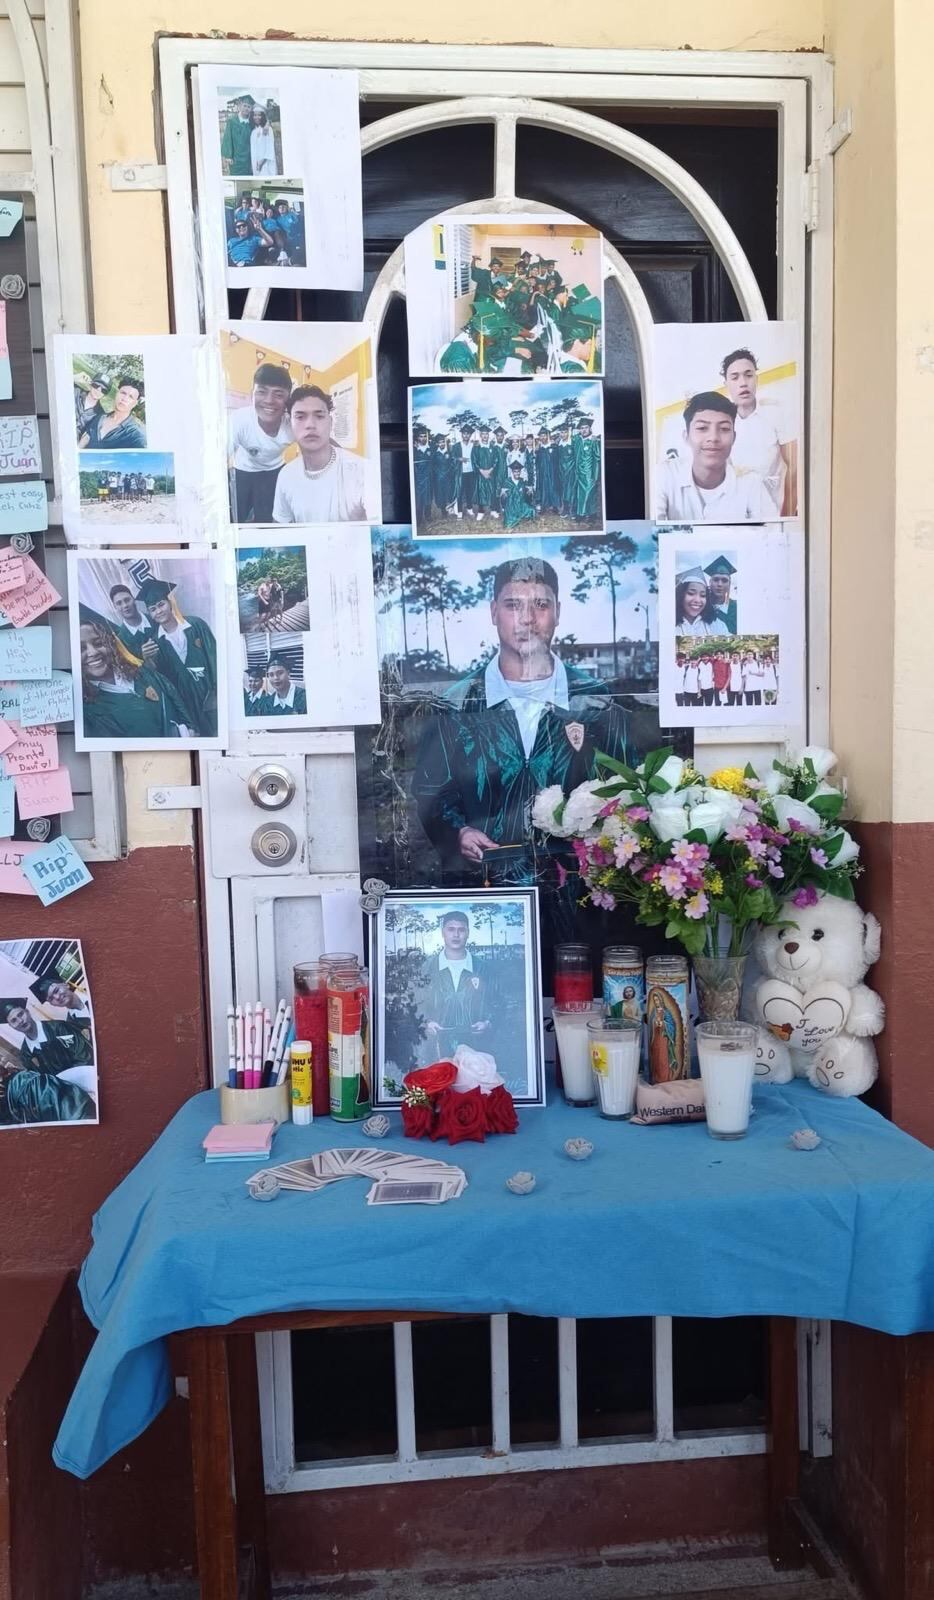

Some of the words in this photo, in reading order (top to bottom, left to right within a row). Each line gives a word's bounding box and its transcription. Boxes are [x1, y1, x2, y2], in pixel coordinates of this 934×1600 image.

[0, 427, 33, 448] IP
[0, 453, 37, 468] Juan
[33, 857, 68, 879] Rip
[804, 1026, 834, 1037] Love
[802, 1038, 821, 1047] you
[640, 1106, 684, 1118] Western
[686, 1103, 706, 1114] Dai
